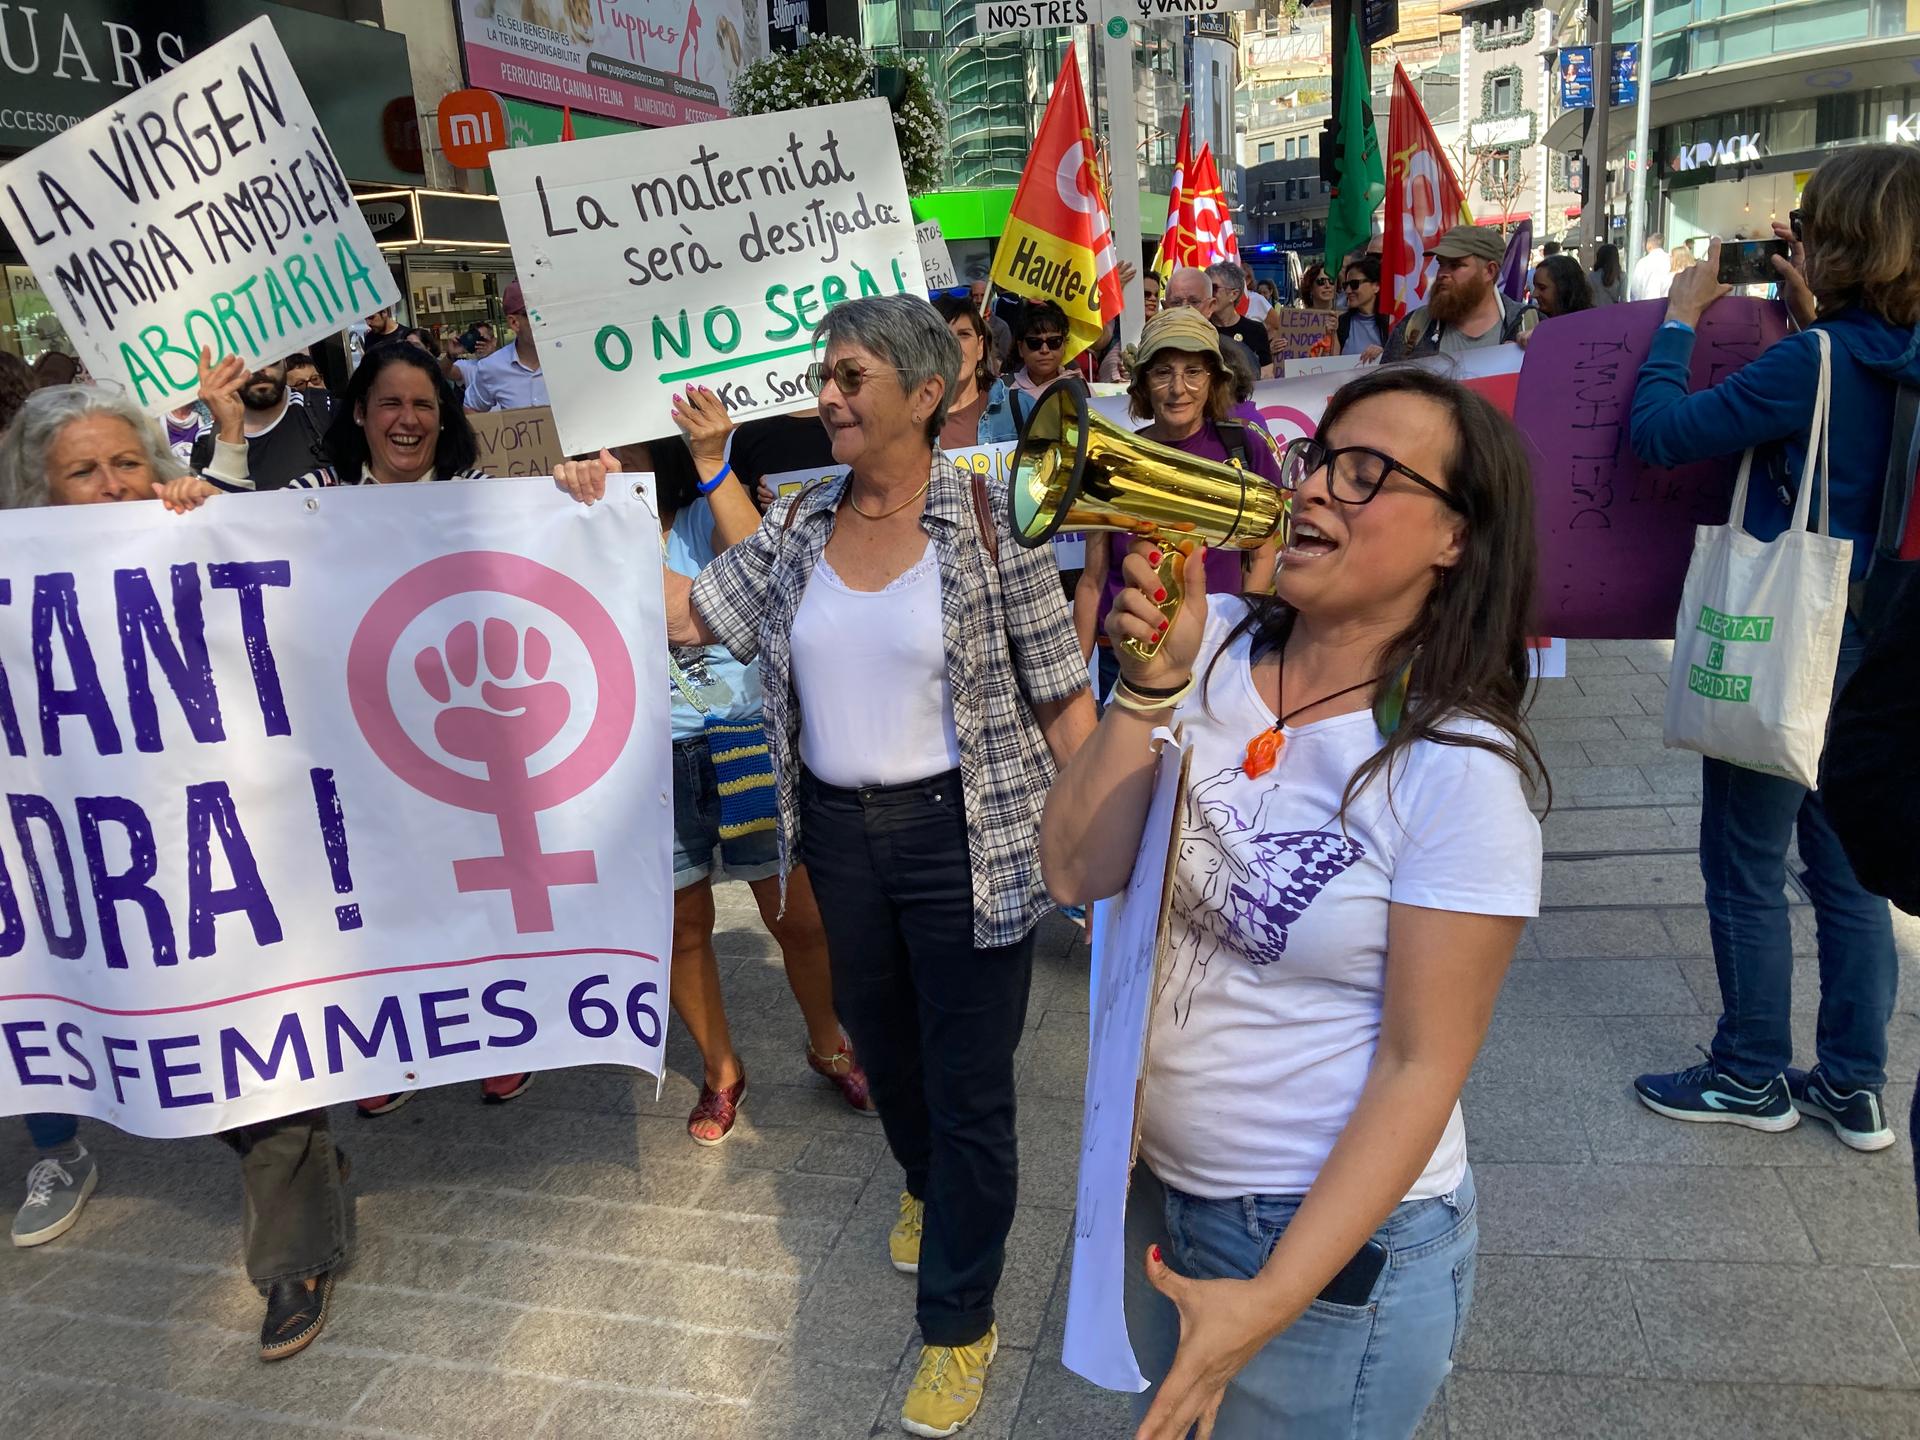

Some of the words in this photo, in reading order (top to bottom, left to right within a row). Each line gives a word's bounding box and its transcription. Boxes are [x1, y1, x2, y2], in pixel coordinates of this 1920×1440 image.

[496, 15, 507, 28] EL
[507, 18, 522, 32] SEU
[523, 22, 560, 43] BENESTAR
[560, 32, 570, 46] ES
[773, 2, 810, 29] SHOPPIN
[987, 0, 1089, 30] NOSTRES
[486, 27, 498, 42] LA
[498, 31, 519, 48] TEVA
[520, 37, 581, 65] RESPONSABILITAT
[500, 62, 562, 92] PERRUQUERIA
[562, 78, 594, 99] CANINA
[599, 87, 624, 107] FELINA
[634, 95, 676, 119] ALIMENTACIÓ
[590, 59, 665, 88] www.puppiesandorra.com
[673, 80, 716, 101] @puppiesandorra
[1680, 132, 1761, 172] KRACK
[536, 175, 618, 238] La
[631, 129, 856, 223] maternitat
[8, 170, 95, 247] LA
[624, 224, 722, 287] serà
[916, 226, 943, 245] RTOS
[926, 268, 954, 290] TAN
[594, 324, 633, 373] O
[652, 304, 743, 361] NO
[1281, 310, 1328, 329] L'ESTAT
[766, 371, 806, 403] Sor
[0, 560, 292, 757] ANT
[1690, 669, 1747, 700] DECIDIR
[0, 781, 284, 969] DRA
[103, 978, 540, 1112] FEMMES
[567, 974, 664, 1049] 66
